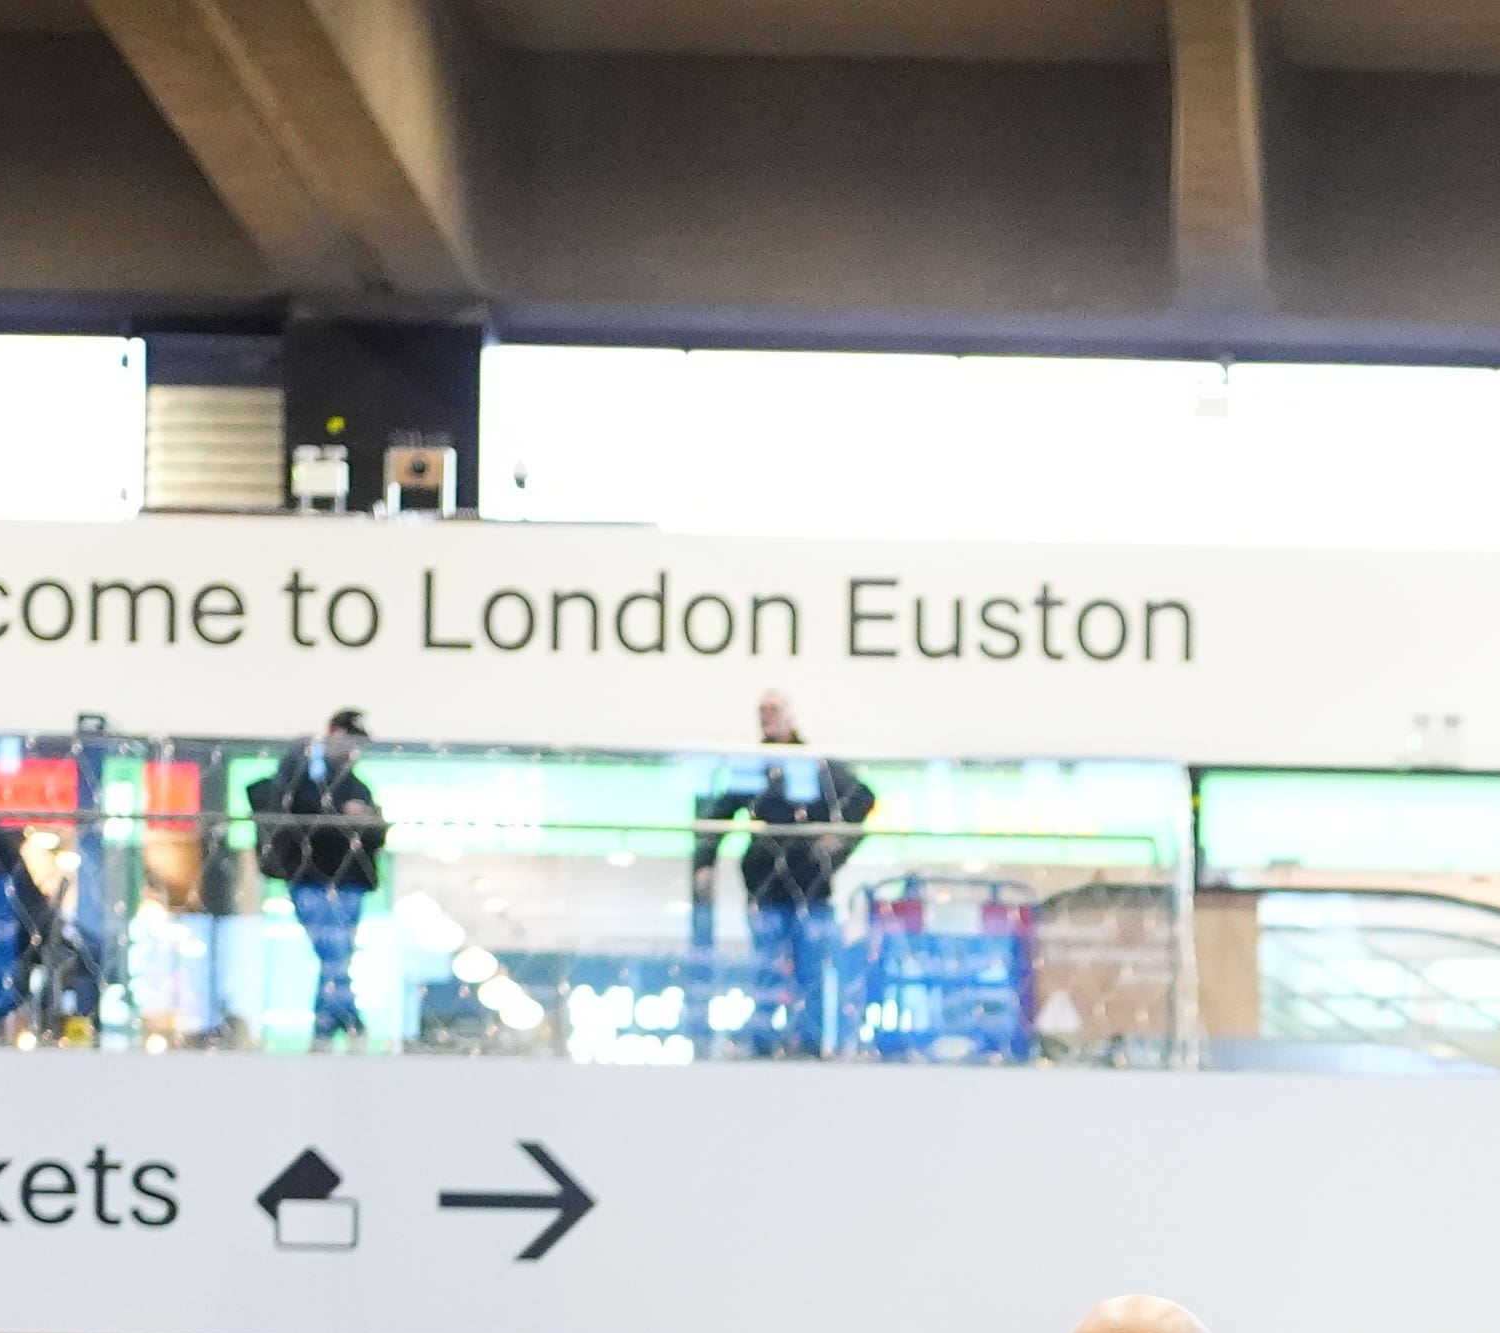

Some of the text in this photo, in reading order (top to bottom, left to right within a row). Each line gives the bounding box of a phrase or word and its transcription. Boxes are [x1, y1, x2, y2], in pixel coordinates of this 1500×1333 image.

[283, 570, 382, 650] to
[423, 569, 800, 657] London
[848, 578, 1194, 663] Euston
